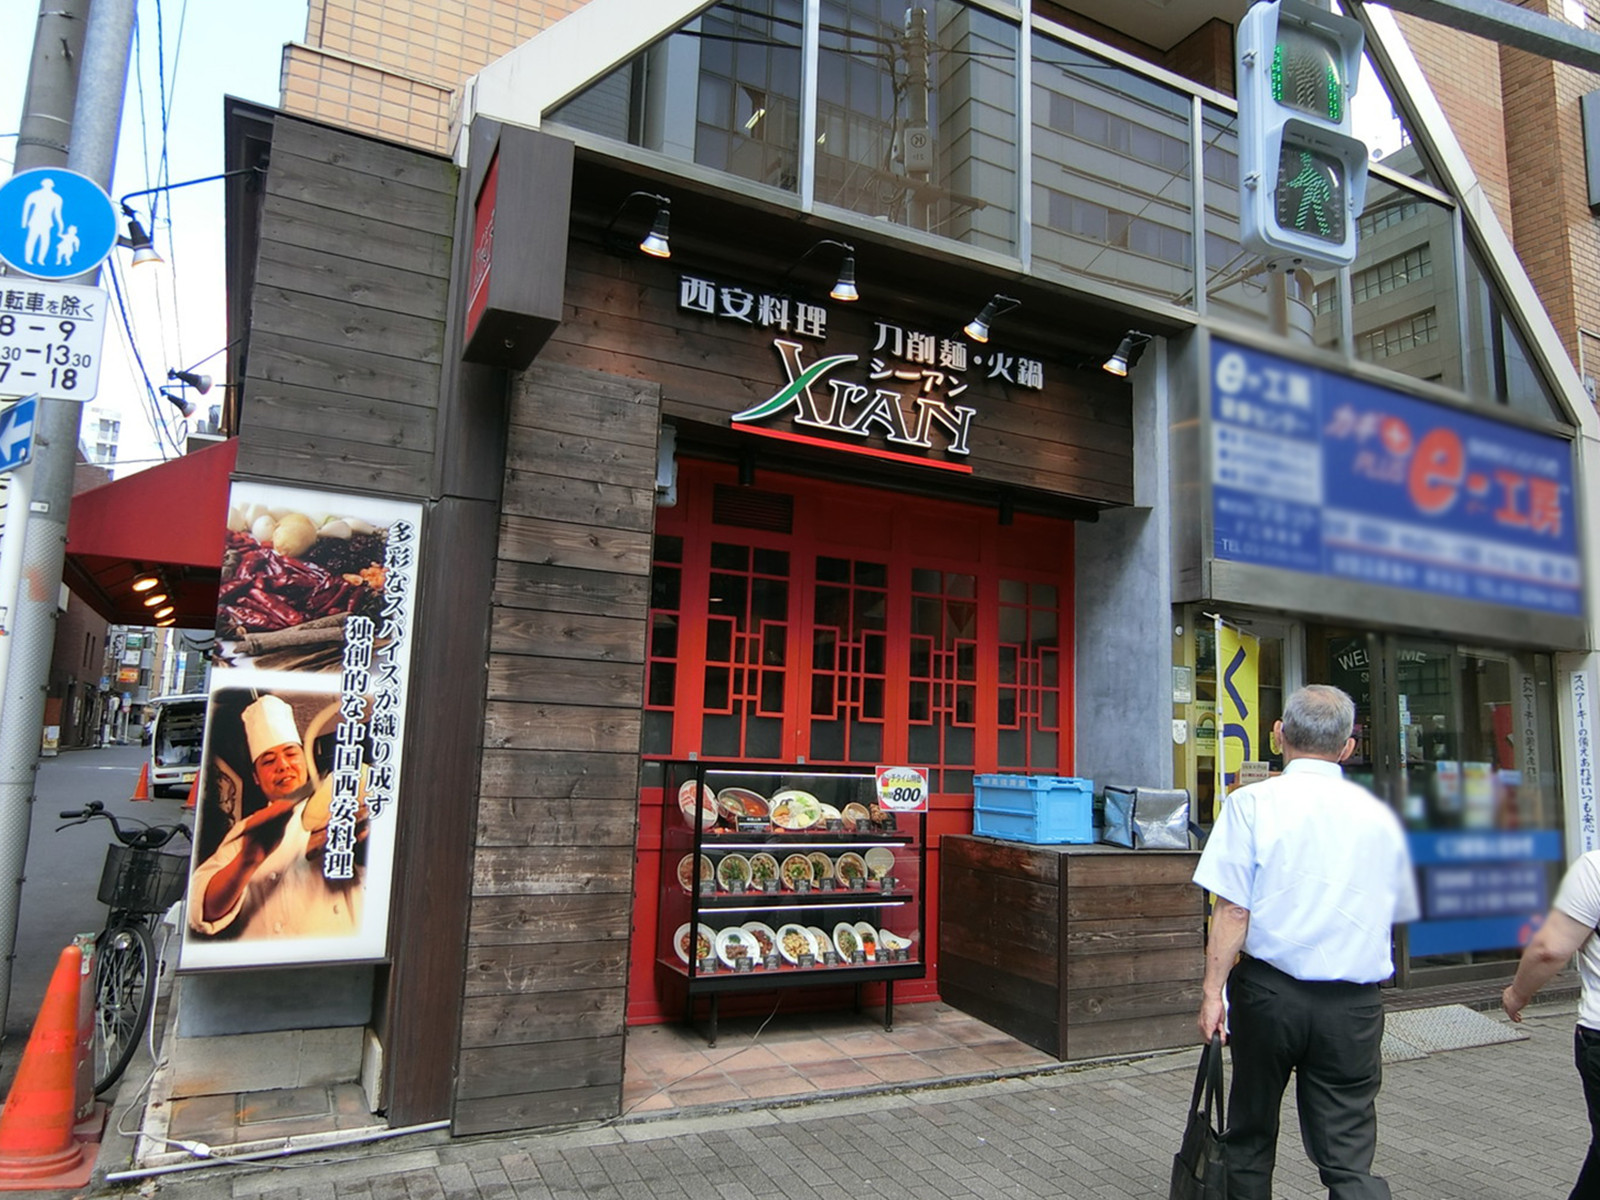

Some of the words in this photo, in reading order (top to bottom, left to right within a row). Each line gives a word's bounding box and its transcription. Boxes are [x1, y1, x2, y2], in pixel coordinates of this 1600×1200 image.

[679, 274, 828, 340] 西安料理
[869, 357, 969, 398] シーアン
[366, 521, 412, 818] 多彩なスパイスが織り成す
[325, 617, 373, 878] 独創的な中国西安料理
[893, 787, 921, 802] 800
